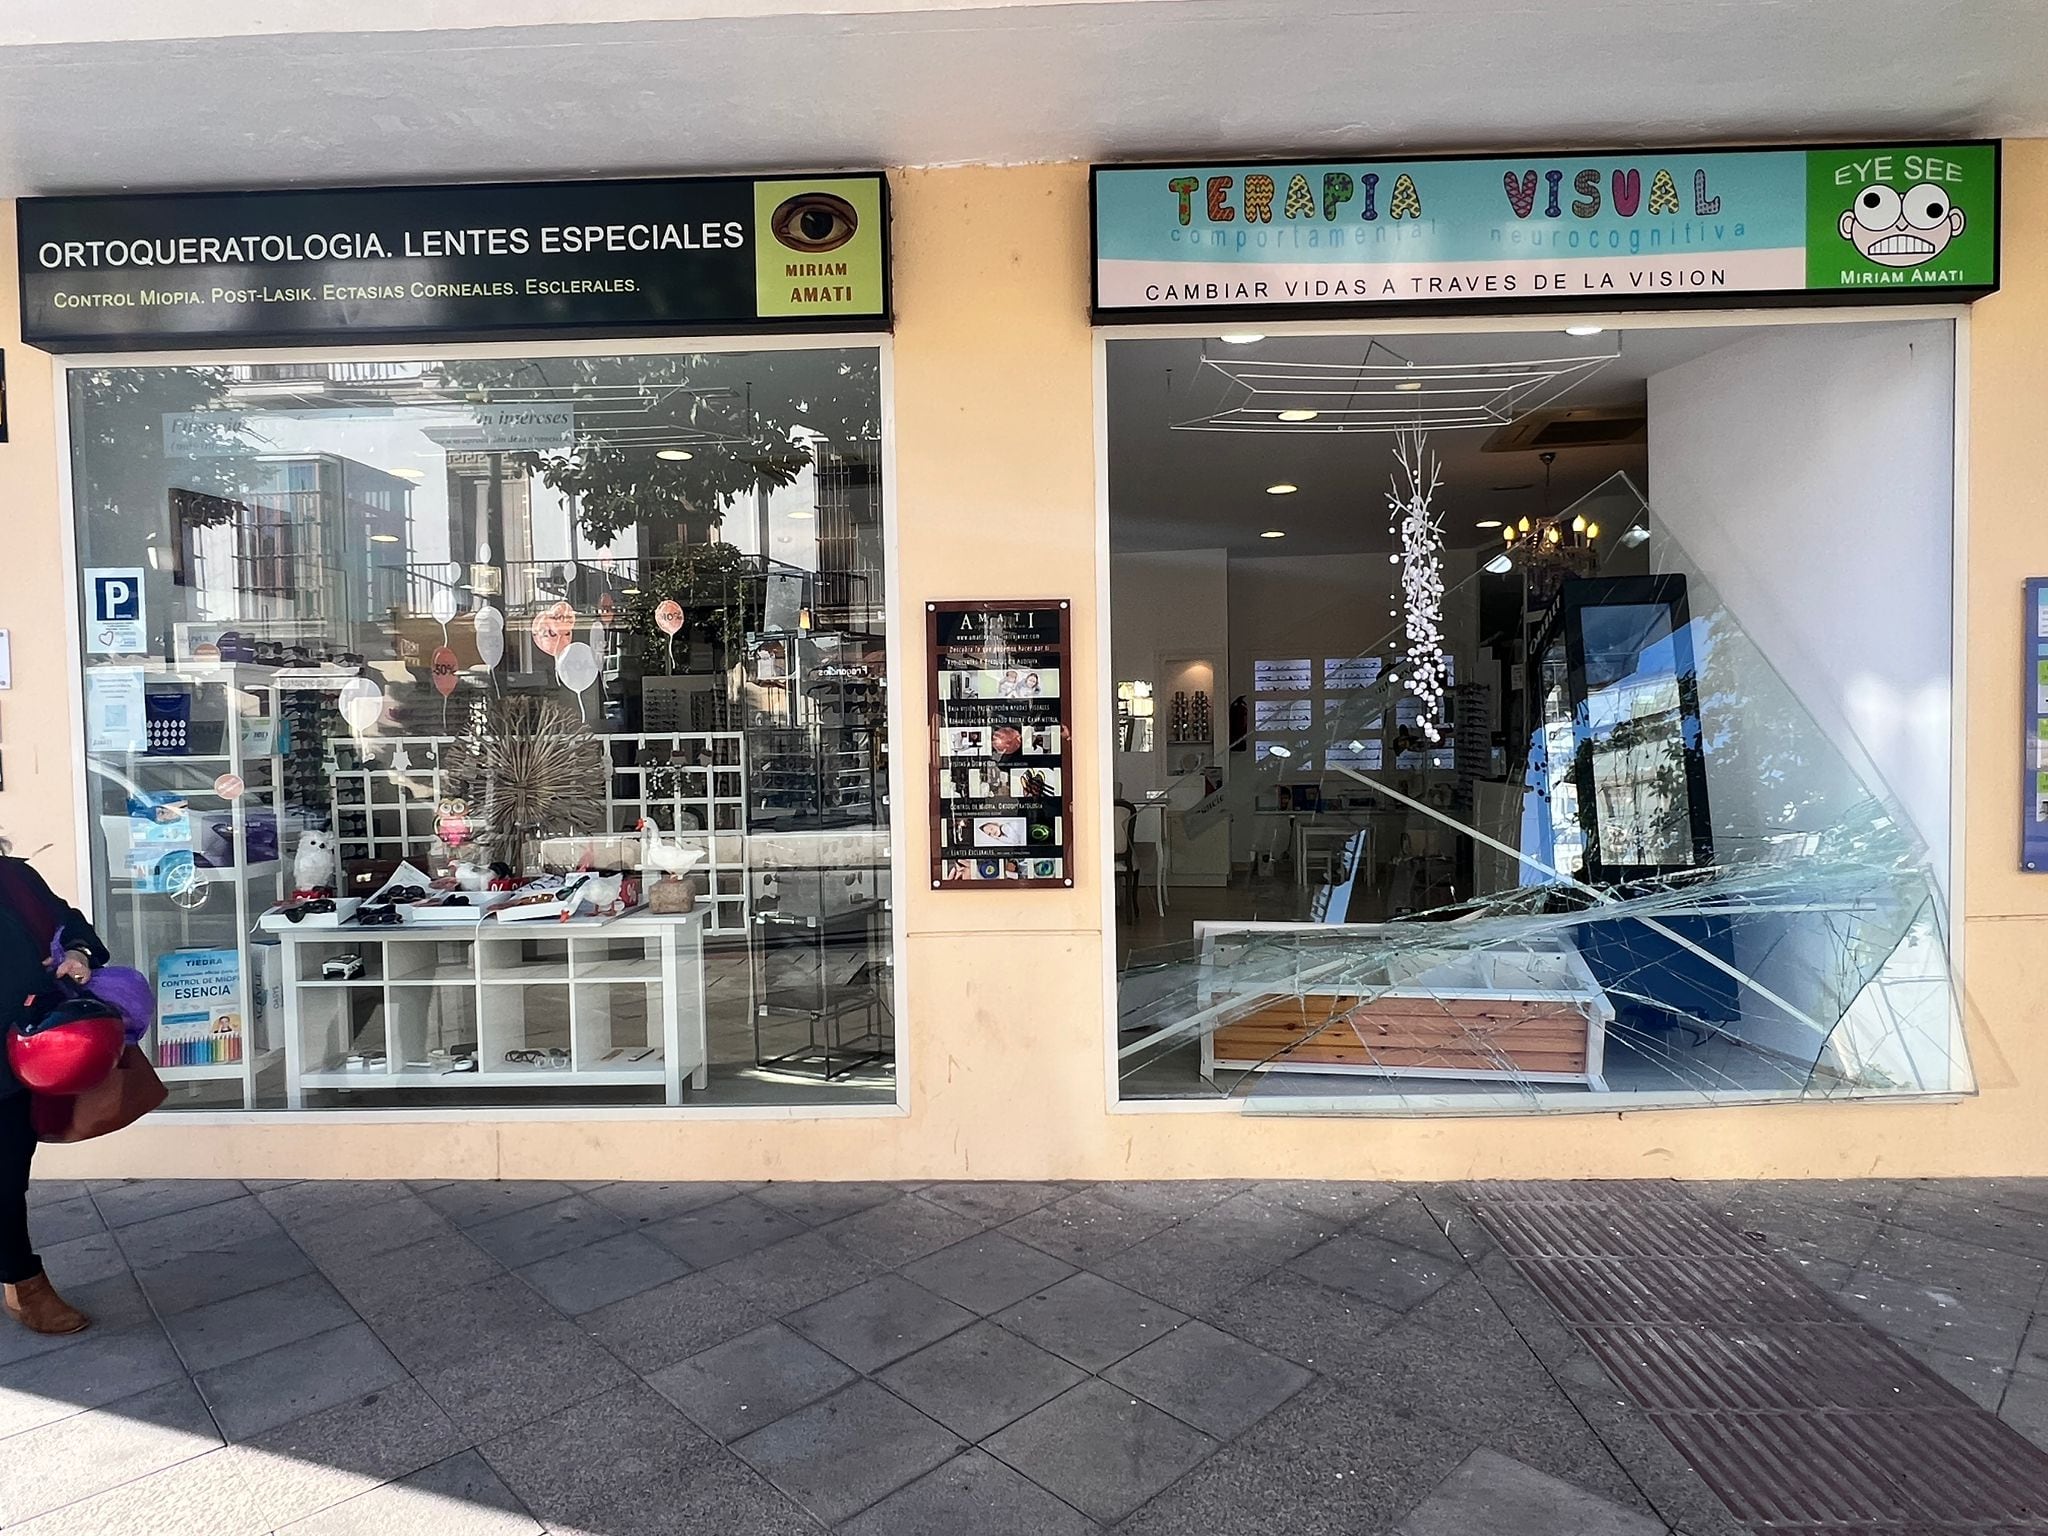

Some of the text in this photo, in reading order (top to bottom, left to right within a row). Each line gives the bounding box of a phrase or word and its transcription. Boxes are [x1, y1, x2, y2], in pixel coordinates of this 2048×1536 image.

[1835, 155, 1963, 186] EYE SEE
[1169, 168, 1721, 226] TERAPIA VISUAL
[39, 221, 744, 268] ORTOQUERATOLOGIA. LENTES ESPECIALES
[1170, 217, 1746, 254] comportamental neurocognitiva
[786, 263, 848, 277] MIRIAM
[1840, 268, 1964, 284] MIRIAM AMATI
[791, 286, 852, 303] AMATI
[1145, 269, 1727, 301] CAMBIAR VIDAS A TRAVES DE LA VISION
[104, 580, 130, 619] P
[960, 612, 1034, 630] AMATI
[161, 978, 201, 988] CONTROL
[174, 984, 231, 999] ESENCIA
